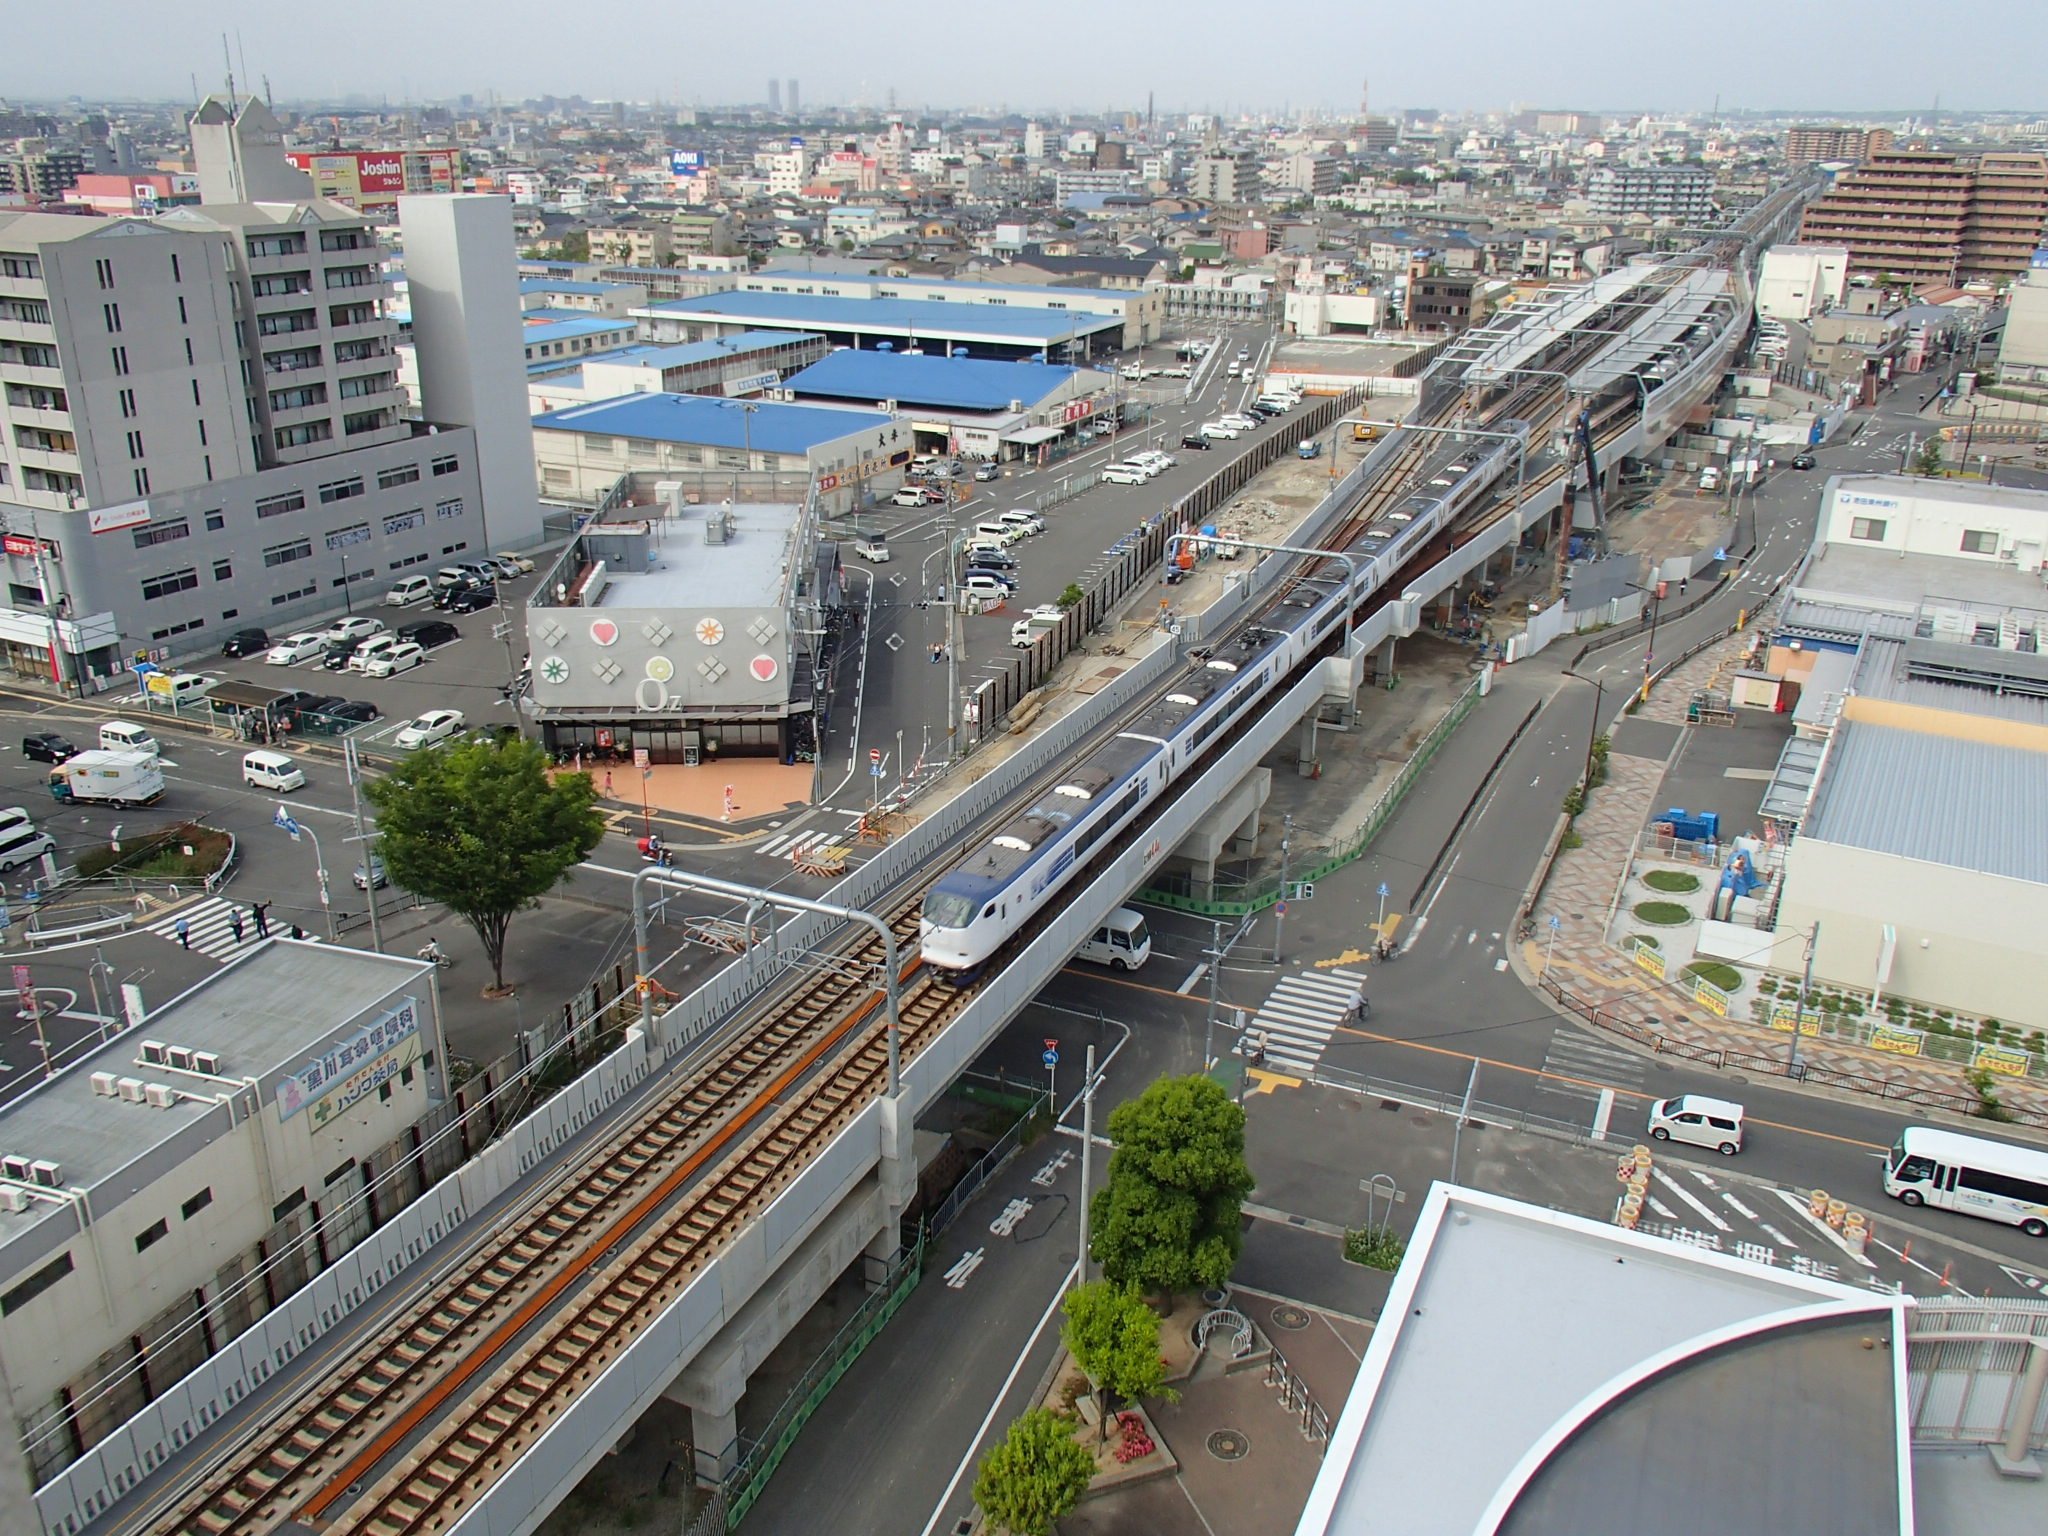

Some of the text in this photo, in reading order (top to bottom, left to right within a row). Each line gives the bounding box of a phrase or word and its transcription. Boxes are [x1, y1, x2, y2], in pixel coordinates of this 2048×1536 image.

[674, 152, 698, 164] AOKI
[361, 159, 401, 176] Joshin
[635, 678, 683, 713] Oz
